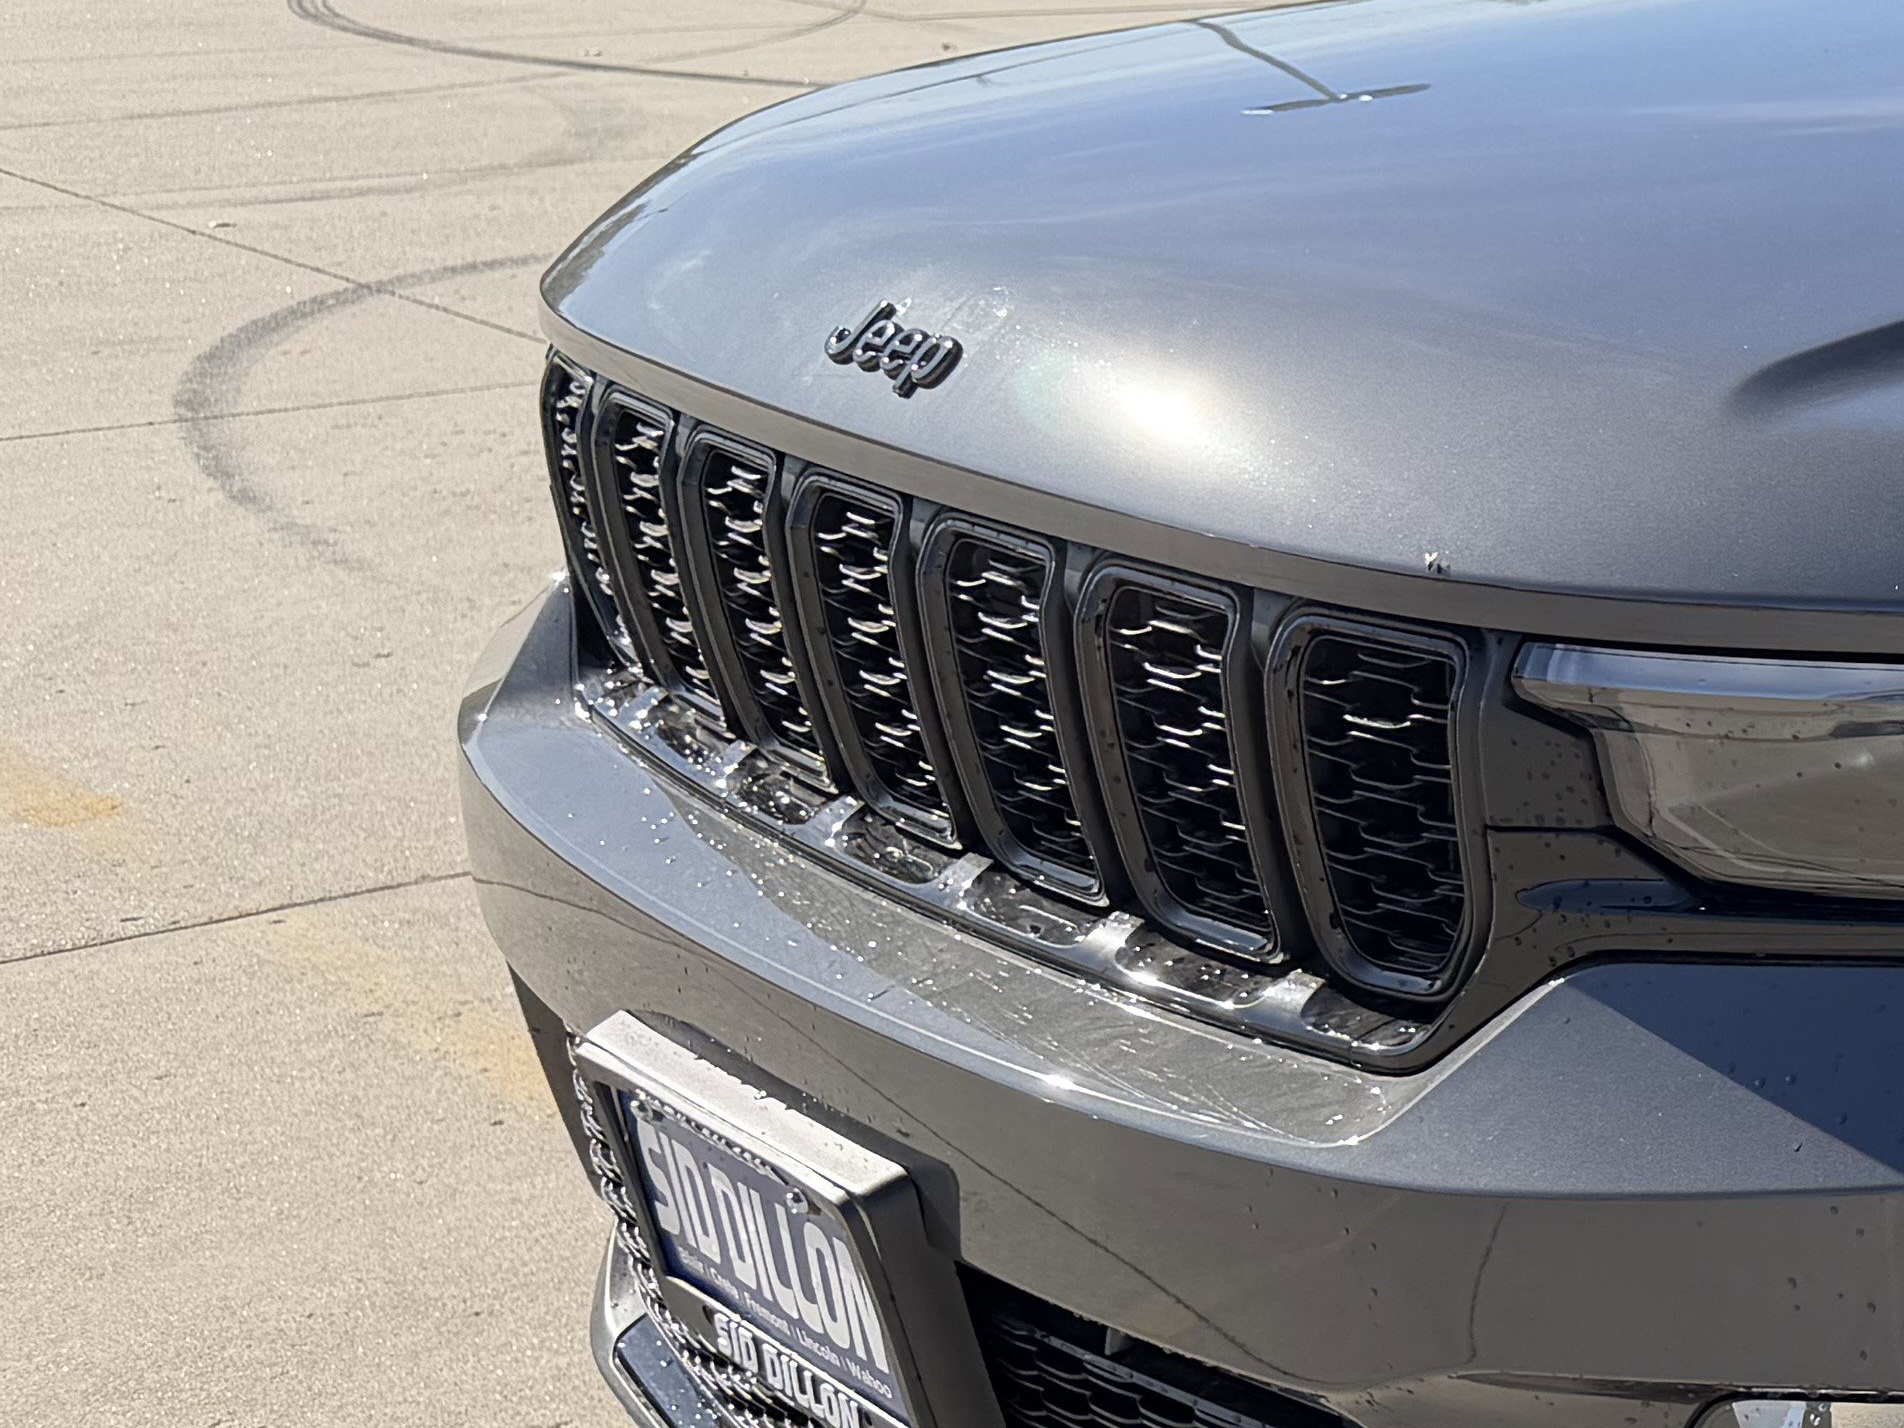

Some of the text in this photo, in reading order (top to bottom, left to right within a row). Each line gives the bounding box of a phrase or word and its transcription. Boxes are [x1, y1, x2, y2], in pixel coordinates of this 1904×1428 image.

[823, 298, 964, 400] Jeep
[636, 1117, 722, 1265] SID
[706, 1161, 890, 1375] DILLON
[713, 1312, 759, 1373] SID
[795, 1327, 841, 1367] Lincoln
[846, 1358, 893, 1399] Wahoo
